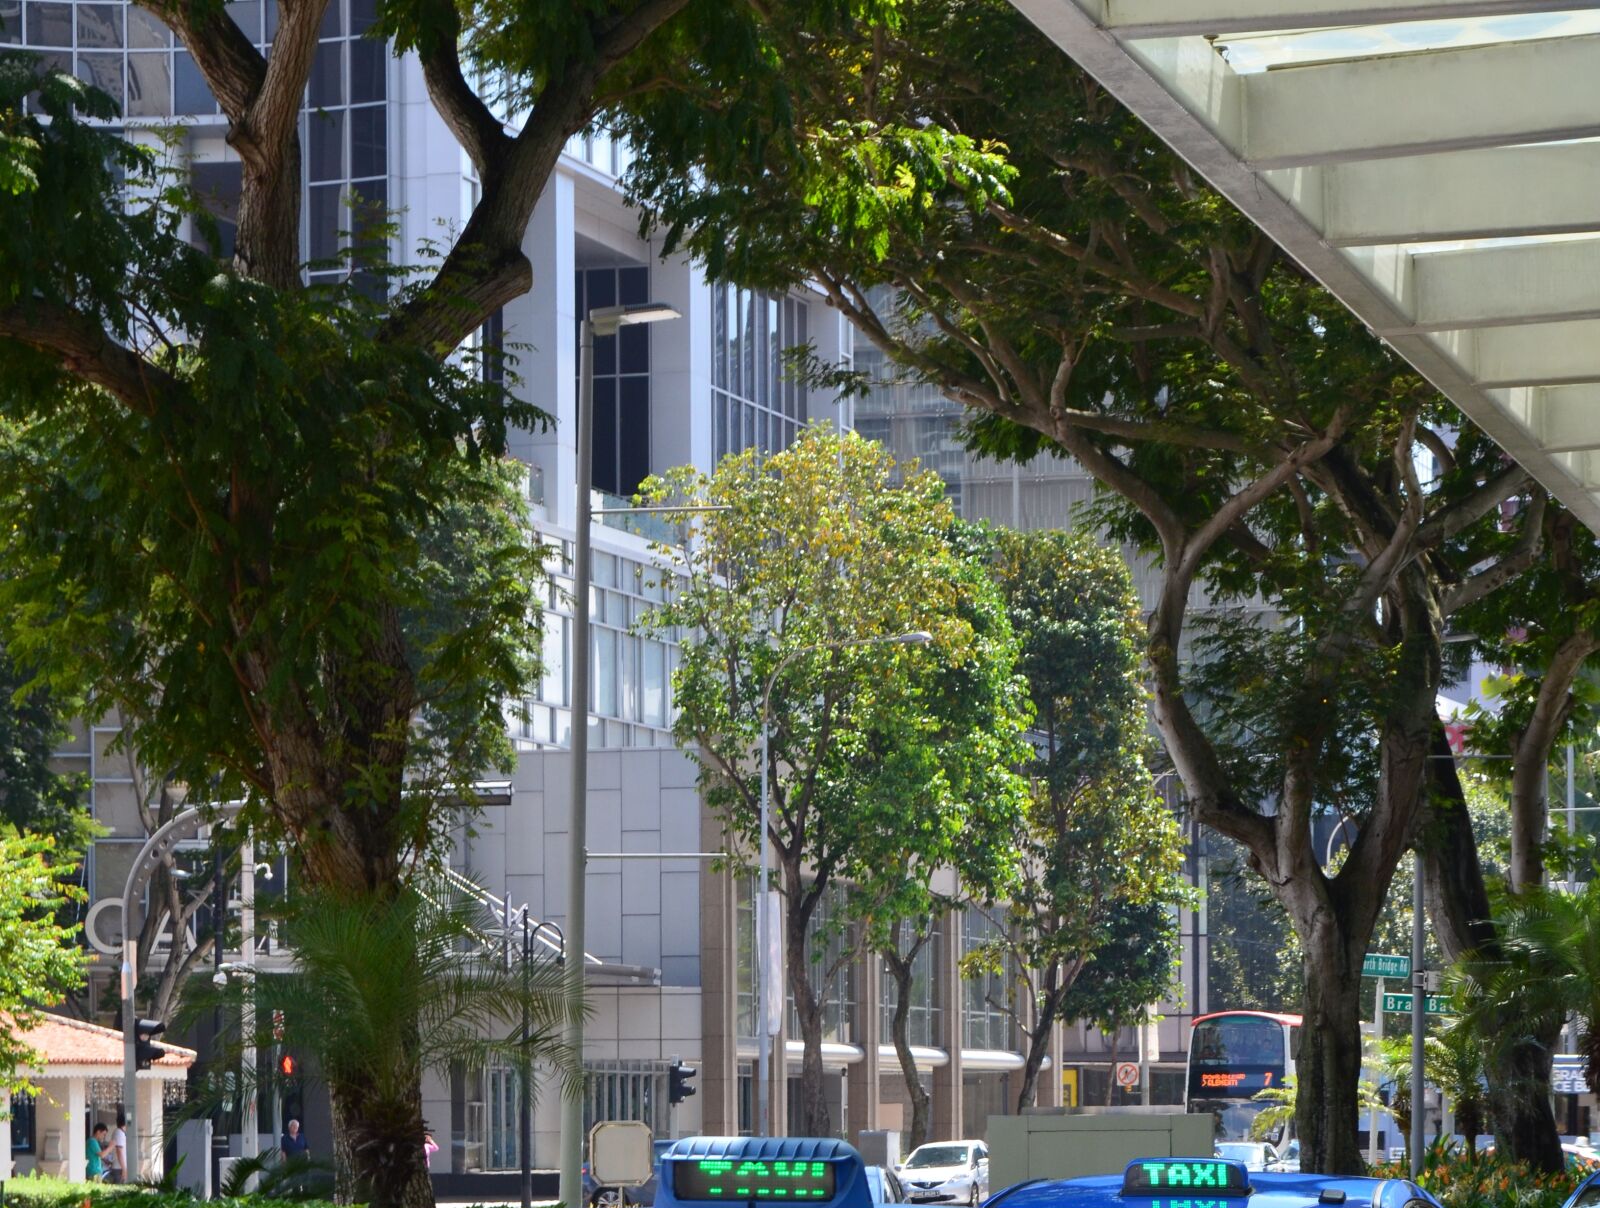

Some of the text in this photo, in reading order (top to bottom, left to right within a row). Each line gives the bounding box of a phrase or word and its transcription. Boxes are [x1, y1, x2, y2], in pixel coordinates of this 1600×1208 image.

[1378, 959, 1398, 974] Bridge
[1400, 959, 1408, 972] Rd
[1387, 996, 1413, 1010] Bra
[1263, 1072, 1273, 1086] 7
[1142, 1162, 1228, 1186] TAXI
